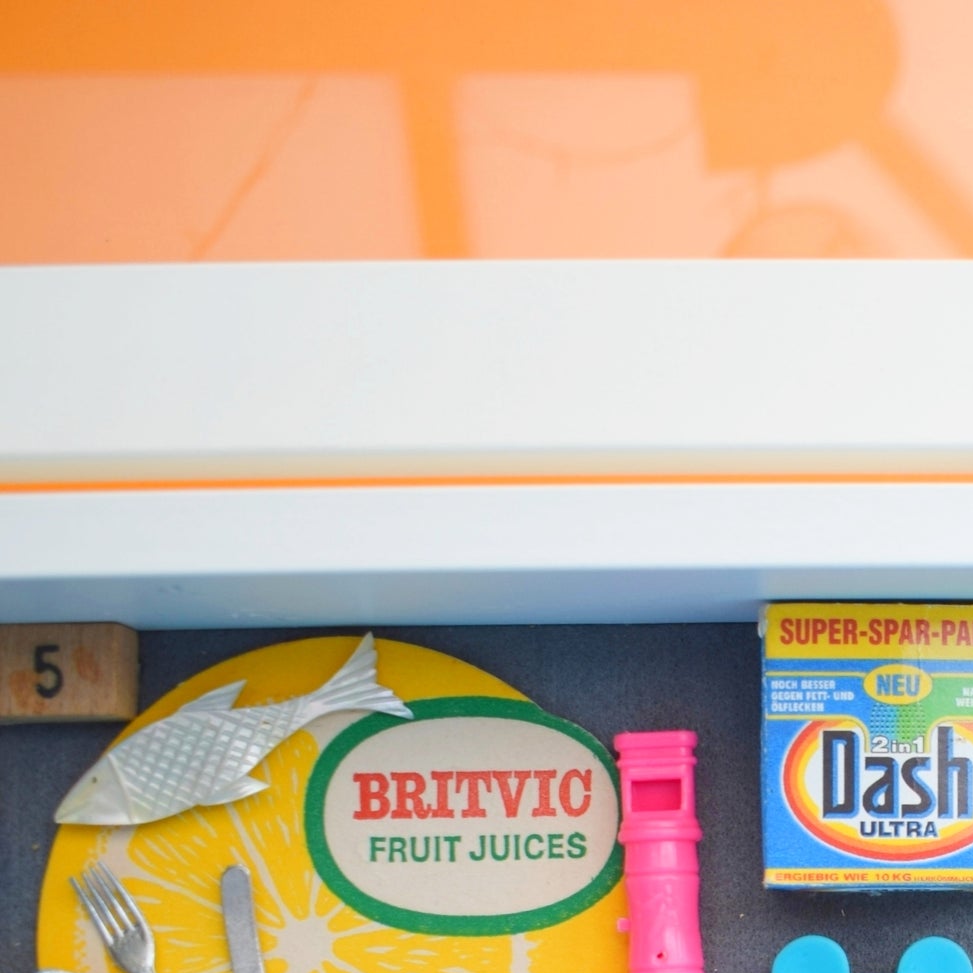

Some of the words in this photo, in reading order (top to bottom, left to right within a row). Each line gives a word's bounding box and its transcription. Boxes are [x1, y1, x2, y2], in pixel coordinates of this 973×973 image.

[34, 644, 63, 698] 5
[771, 680, 798, 690] NOCH
[801, 680, 836, 690] BESSER
[876, 674, 920, 697] NEU
[771, 691, 803, 701] GEGEN
[834, 692, 855, 701] UND
[352, 768, 593, 820] BRITVIC
[860, 821, 939, 838] ULTRA
[370, 835, 460, 862] FRUIT
[469, 831, 588, 861] JUICES
[775, 873, 838, 882] ERGIEBIG
[844, 873, 869, 882] WIE
[875, 873, 890, 882] 10
[892, 873, 912, 883] KG
